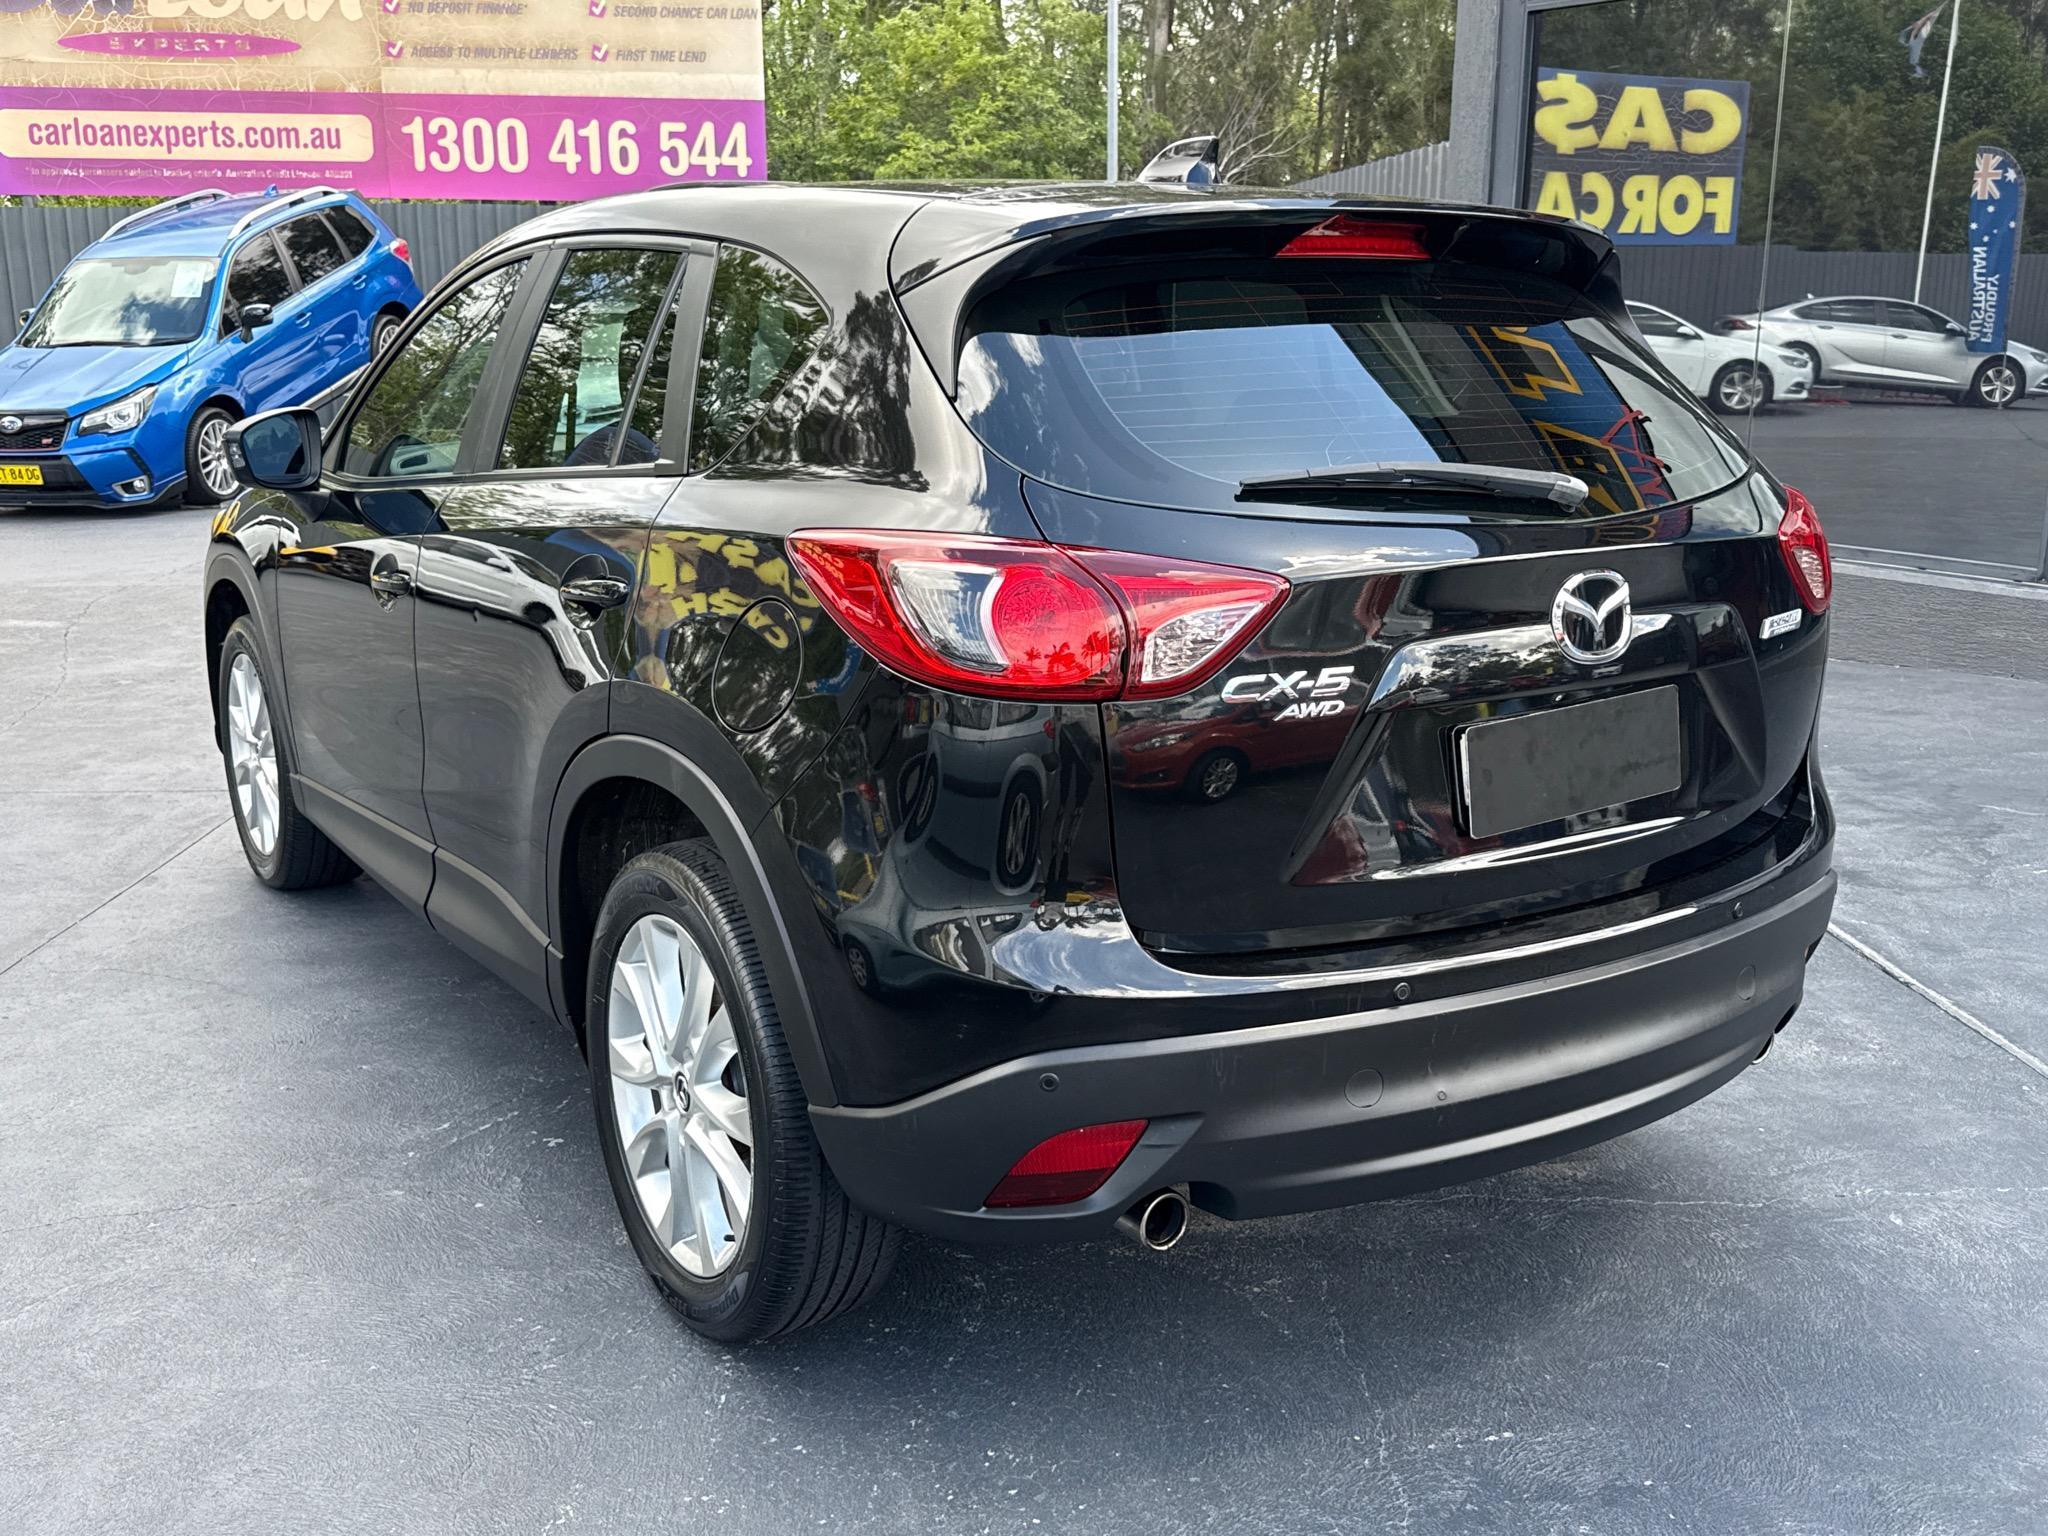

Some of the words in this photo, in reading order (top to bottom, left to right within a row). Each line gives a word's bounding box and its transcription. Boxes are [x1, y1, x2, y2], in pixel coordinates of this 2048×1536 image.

[613, 5, 657, 18] SECOND
[660, 6, 705, 19] CHANCE
[706, 7, 728, 20] CAR
[730, 8, 758, 20] LOAN
[457, 47, 471, 59] TO
[473, 47, 526, 60] MULTIPLE
[616, 50, 646, 62] FIRST
[650, 50, 676, 63] TIME
[678, 51, 706, 63] LEND
[28, 117, 341, 154] carloanexperts.com.au
[401, 115, 529, 174] 1300
[548, 118, 640, 176] 416
[659, 121, 753, 178] 544
[1221, 665, 1355, 704] CX-5
[1273, 699, 1346, 722] AWD
